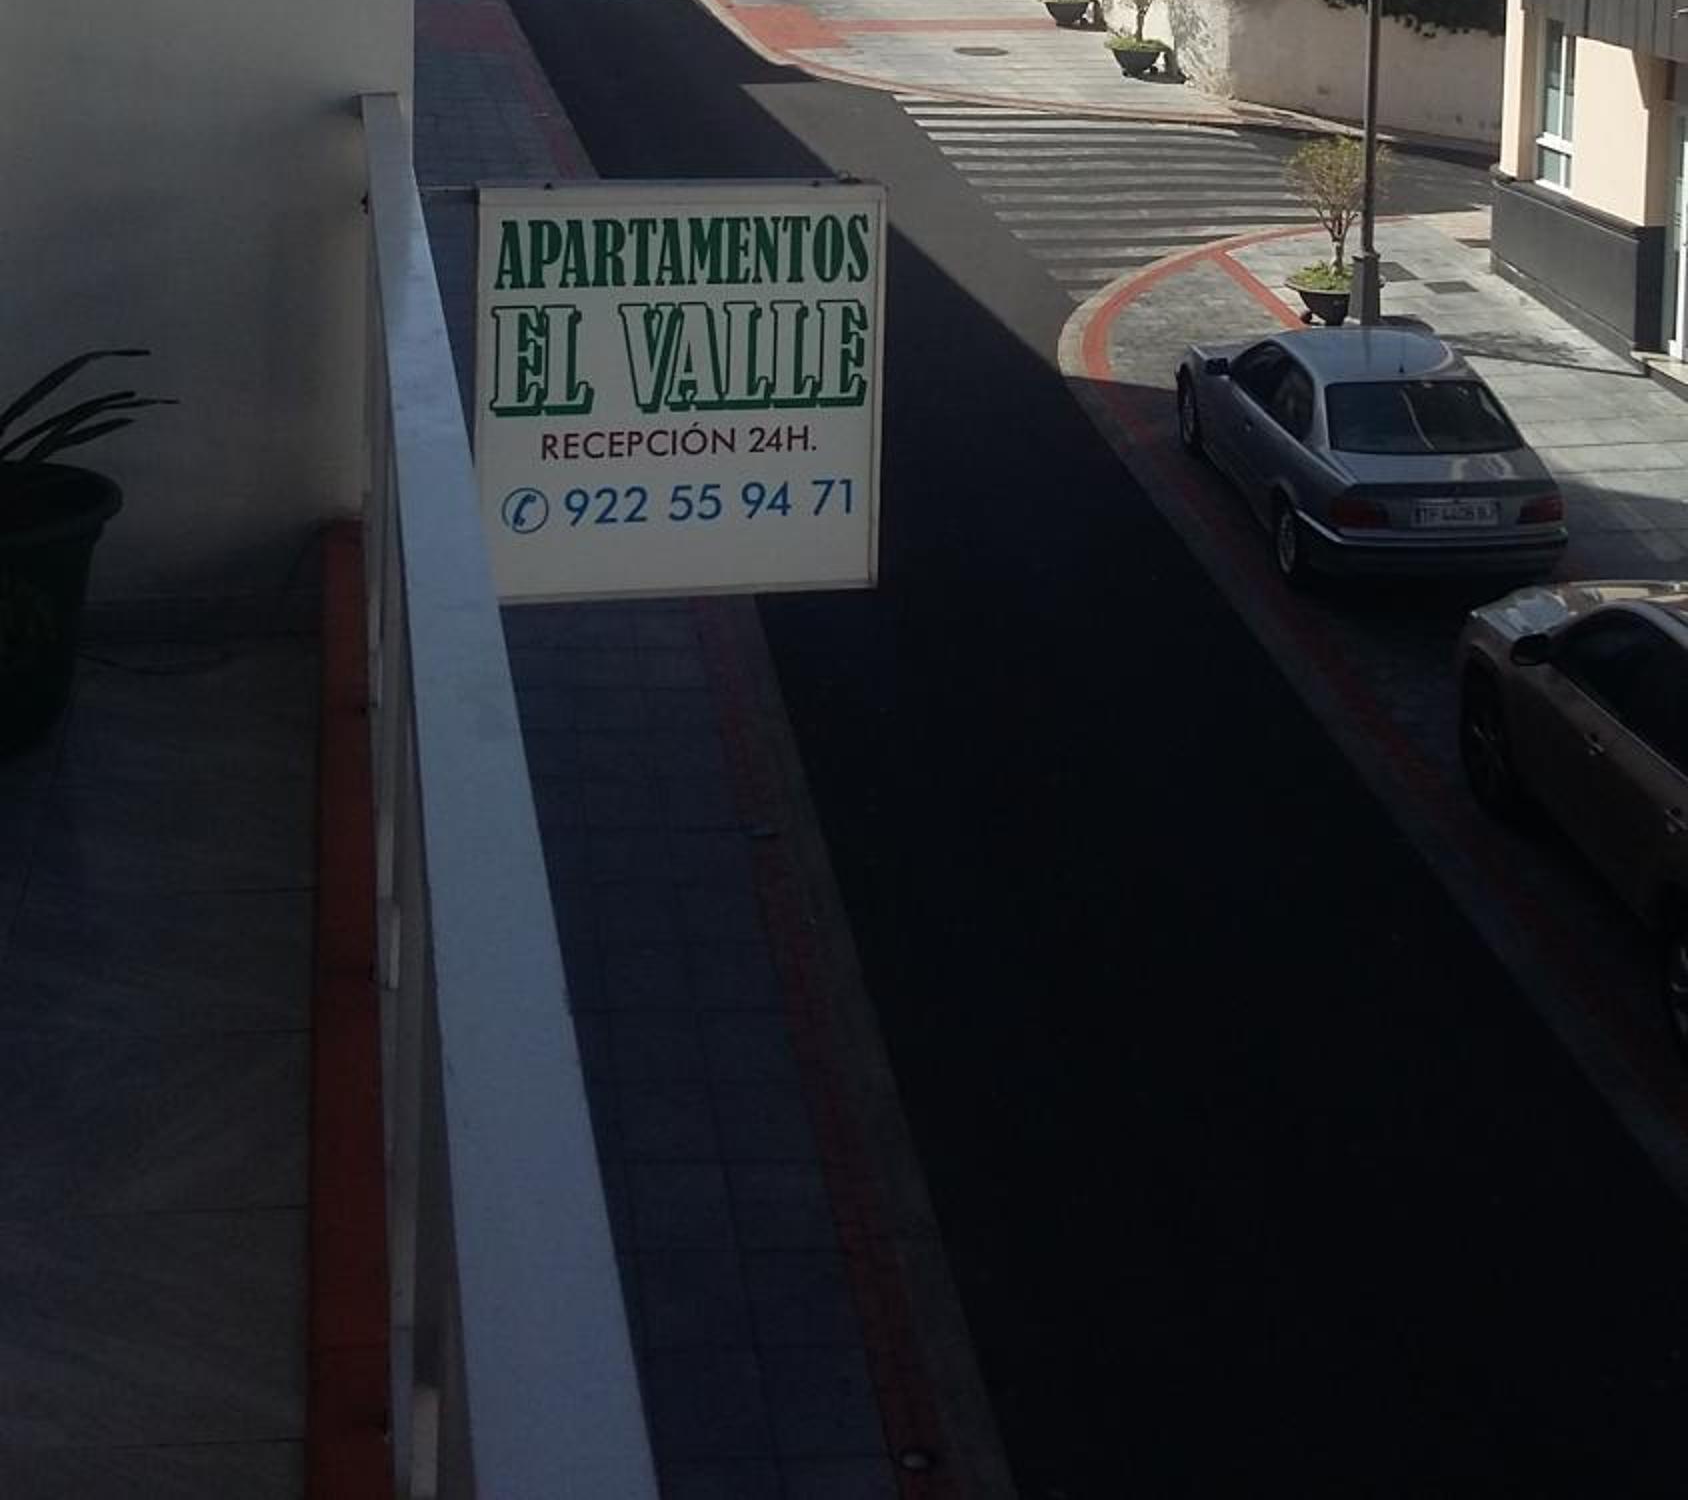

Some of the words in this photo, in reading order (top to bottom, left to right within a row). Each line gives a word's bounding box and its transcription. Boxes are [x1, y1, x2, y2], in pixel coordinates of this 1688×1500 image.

[495, 215, 868, 289] APARTAMENTOS
[490, 304, 594, 417] EL
[619, 299, 868, 414] VALLE
[542, 422, 736, 460] RECEPCIÓN
[749, 426, 818, 454] 24H.
[564, 487, 649, 526] 922
[668, 485, 722, 521] 55
[741, 482, 792, 518] 94
[811, 479, 854, 516] 71
